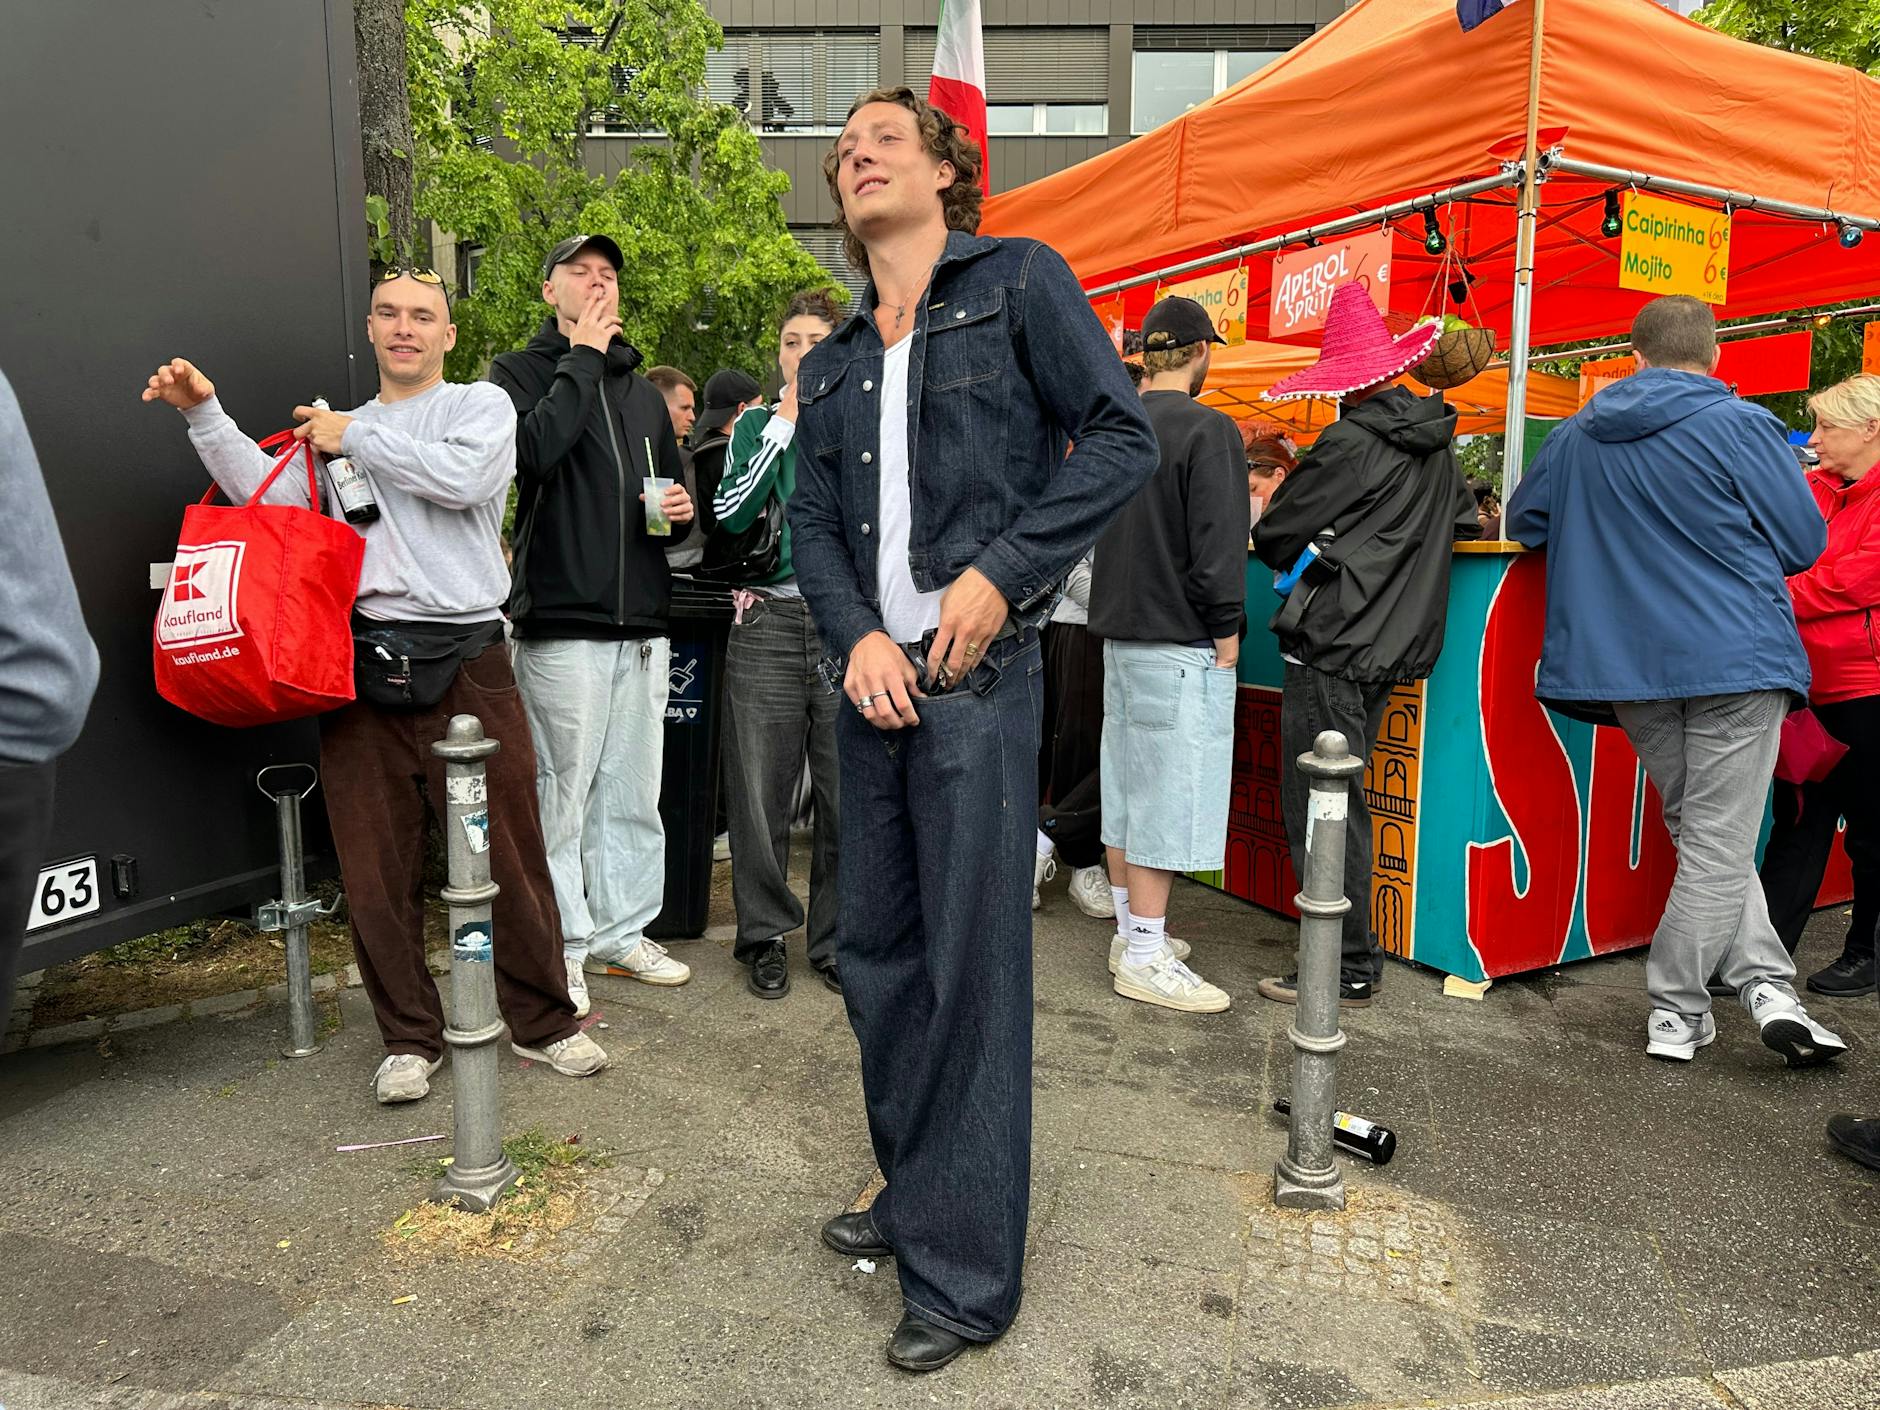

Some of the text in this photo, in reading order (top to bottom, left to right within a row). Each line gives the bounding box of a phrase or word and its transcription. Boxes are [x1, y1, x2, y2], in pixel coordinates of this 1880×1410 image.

[1627, 209, 1729, 250] Caipirinha 6 €
[1274, 248, 1349, 315] APEROL
[1377, 263, 1389, 283] €
[1624, 250, 1727, 284] Mojito 6 €
[1227, 272, 1239, 307] 6
[1218, 308, 1230, 334] 6
[163, 604, 223, 628] Kaufland
[172, 646, 241, 667] kaufland.de
[41, 866, 92, 916] 63
